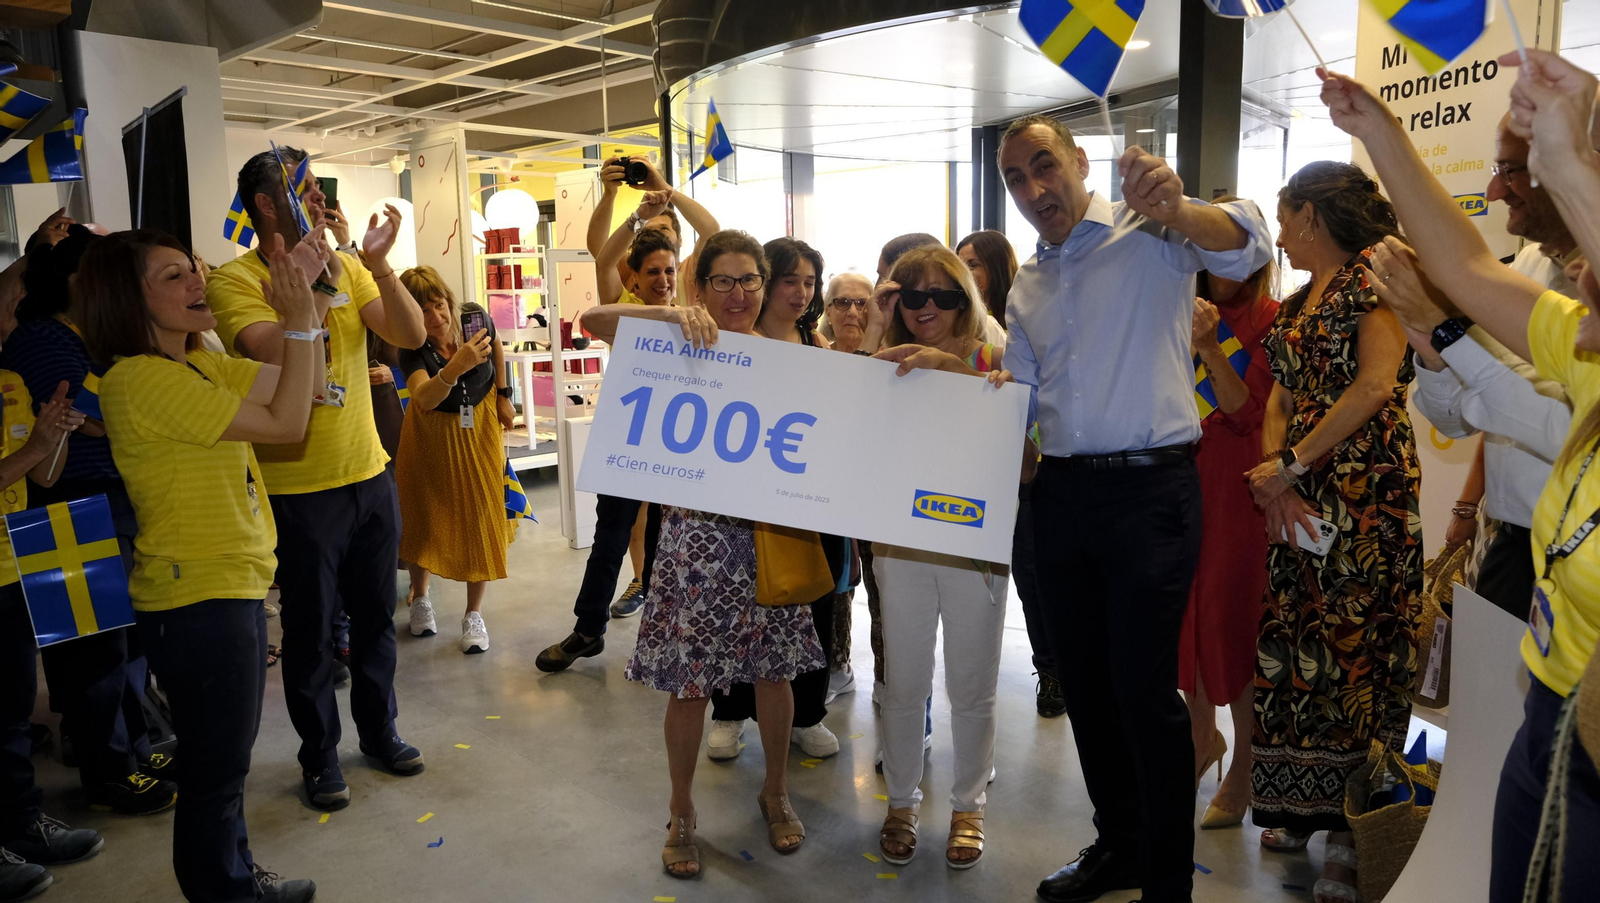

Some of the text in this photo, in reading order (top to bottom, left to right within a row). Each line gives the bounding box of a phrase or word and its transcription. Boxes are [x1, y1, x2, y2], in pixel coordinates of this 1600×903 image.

[1382, 43, 1408, 70] Mi
[1380, 60, 1498, 102] momento
[1433, 143, 1447, 156] de
[1445, 159, 1484, 173] calma
[634, 336, 753, 367] IKEA Almería
[632, 367, 723, 389] Cheque regalo de
[620, 386, 818, 474] 100€
[605, 454, 706, 480] #Cien euros#
[789, 491, 804, 499] julio
[814, 495, 830, 504] 2023
[920, 499, 978, 519] IKEA
